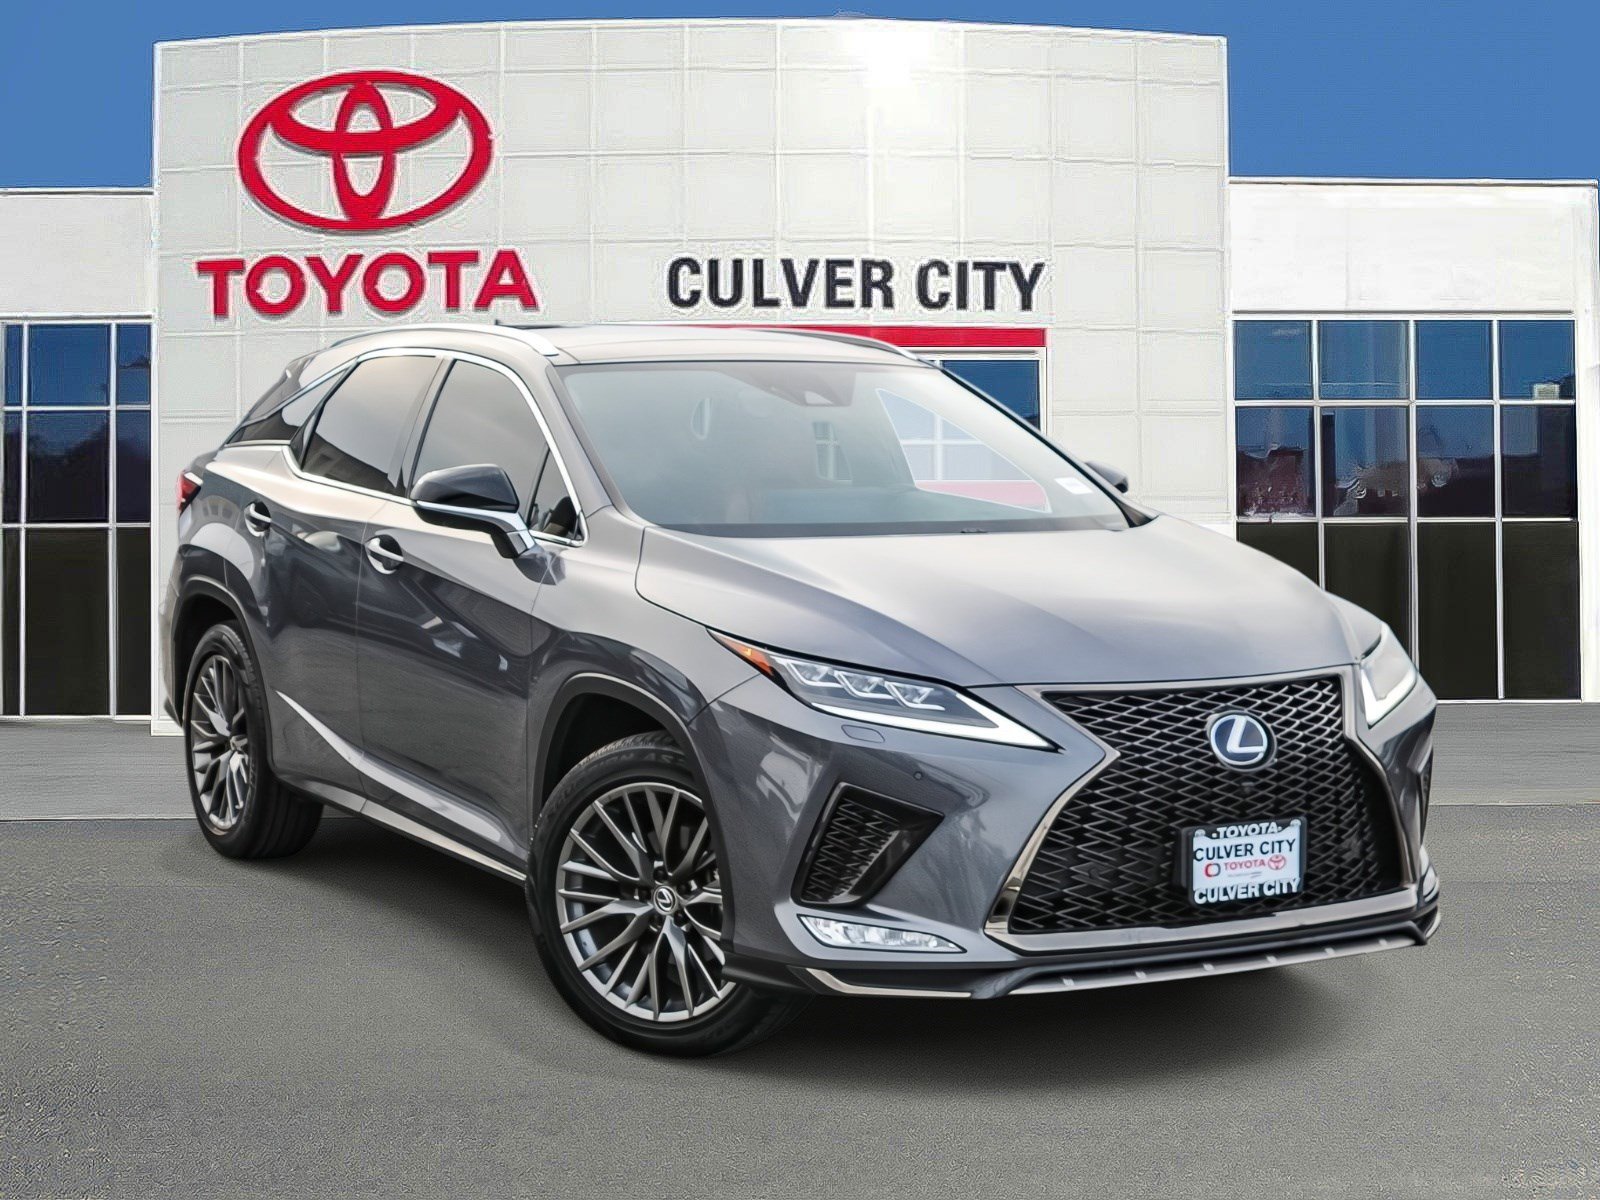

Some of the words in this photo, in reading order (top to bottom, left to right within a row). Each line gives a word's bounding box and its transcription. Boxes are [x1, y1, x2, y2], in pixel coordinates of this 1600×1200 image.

[196, 249, 540, 319] TOYOTA
[667, 257, 895, 309] CULVER
[915, 259, 1046, 311] CITY
[1216, 822, 1279, 839] TOYOTA
[1193, 843, 1254, 862] CULVER
[1259, 838, 1296, 855] CITY
[1224, 859, 1266, 871] TOYOTA
[1194, 882, 1260, 904] CULVER
[1262, 877, 1301, 897] CITY
